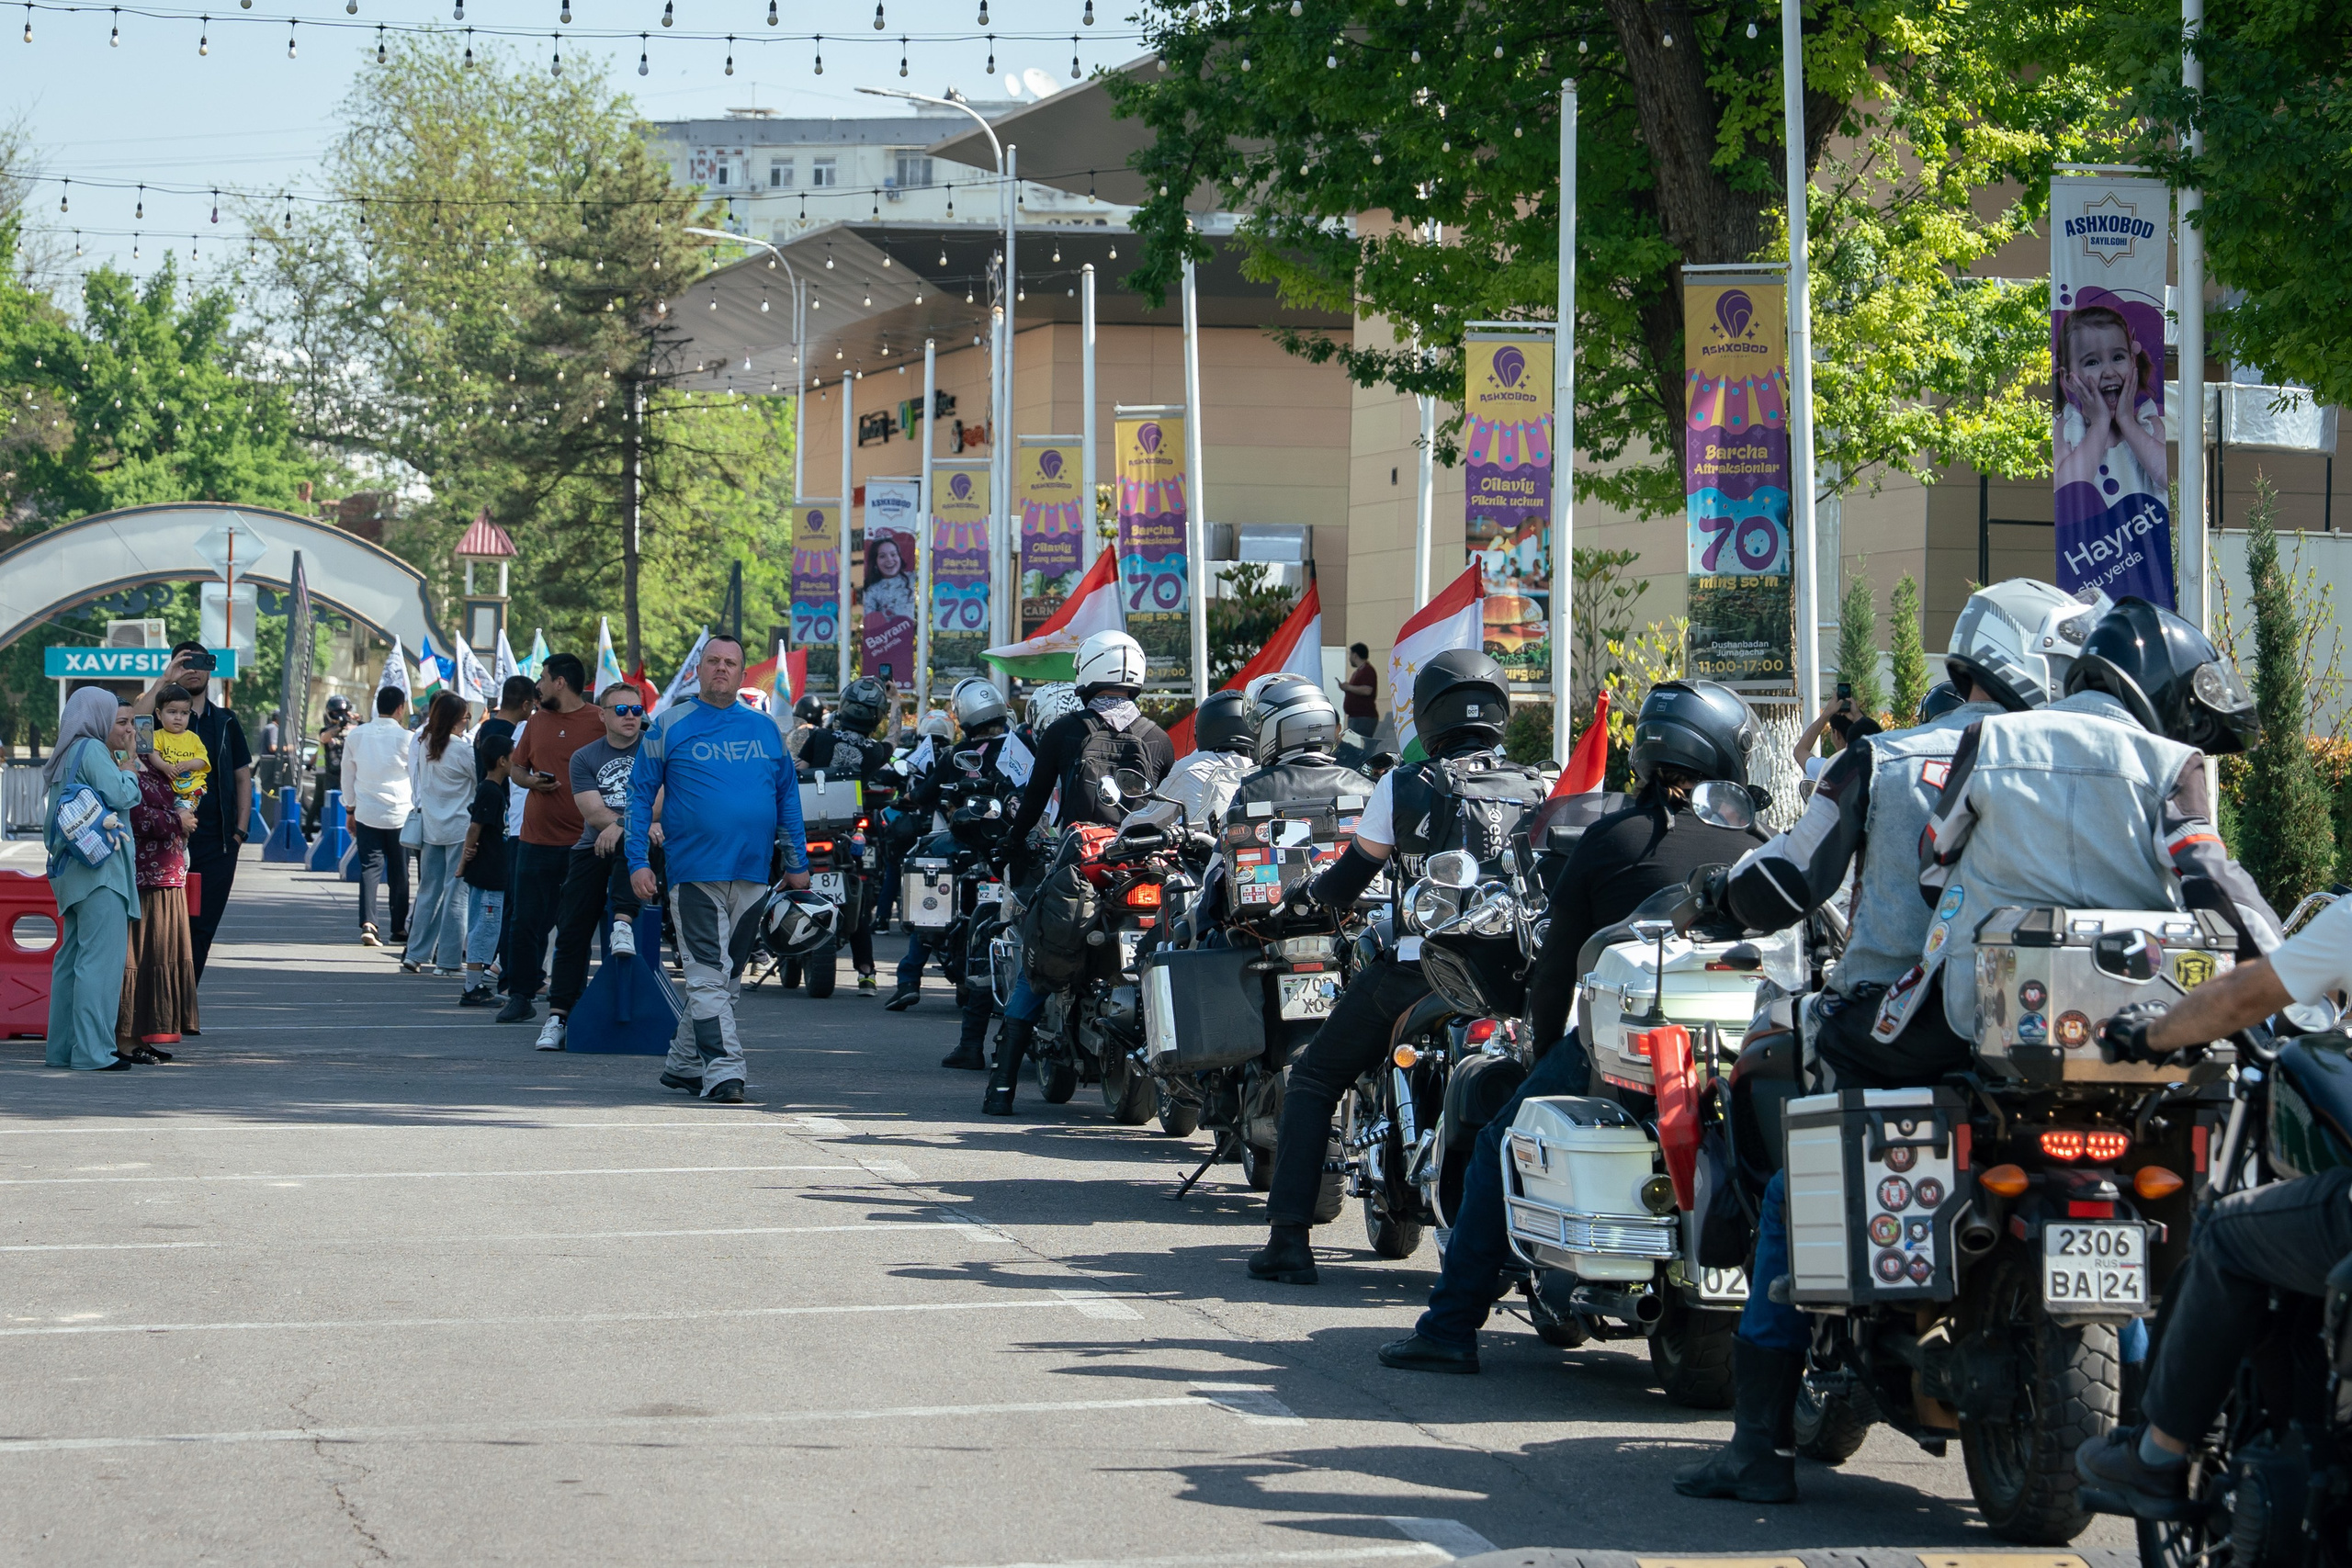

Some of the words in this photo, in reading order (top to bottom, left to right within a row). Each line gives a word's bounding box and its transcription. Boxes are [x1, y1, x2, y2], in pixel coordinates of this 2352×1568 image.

[2064, 215, 2154, 239] ASHXOBOD
[2090, 236, 2127, 245] SAYILGOHI
[1702, 343, 1769, 356] ASHXOBOD
[1479, 391, 1537, 402] ASHXOBOD
[1705, 443, 1769, 460] Barcha
[1694, 462, 1781, 475] Attraksionlar
[1480, 477, 1535, 495] Oilaviy
[1471, 495, 1507, 506] Piknik
[1510, 496, 1544, 506] uchun
[1131, 525, 1174, 536] Barcha
[2064, 502, 2164, 576] Hayrat
[1699, 515, 1779, 571] 70
[2103, 551, 2144, 584] yerda
[1127, 572, 1182, 610] 70
[1700, 576, 1737, 591] ming
[1740, 574, 1779, 588] so'm
[939, 597, 983, 629] 70
[1023, 606, 1058, 616] CARN
[796, 615, 833, 641] 70
[865, 620, 910, 649] Bayram
[1711, 640, 1770, 649] Dushanbadan
[1716, 649, 1765, 658] Jumagacha
[1698, 659, 1784, 673] 11:00-17:00
[1504, 669, 1544, 682] urger
[821, 873, 840, 887] 87
[2059, 1229, 2130, 1257] 2306
[2095, 1259, 2118, 1268] RUS
[1704, 1267, 1746, 1294] 02
[2052, 1270, 2092, 1298] BA
[2104, 1271, 2139, 1299] 24
